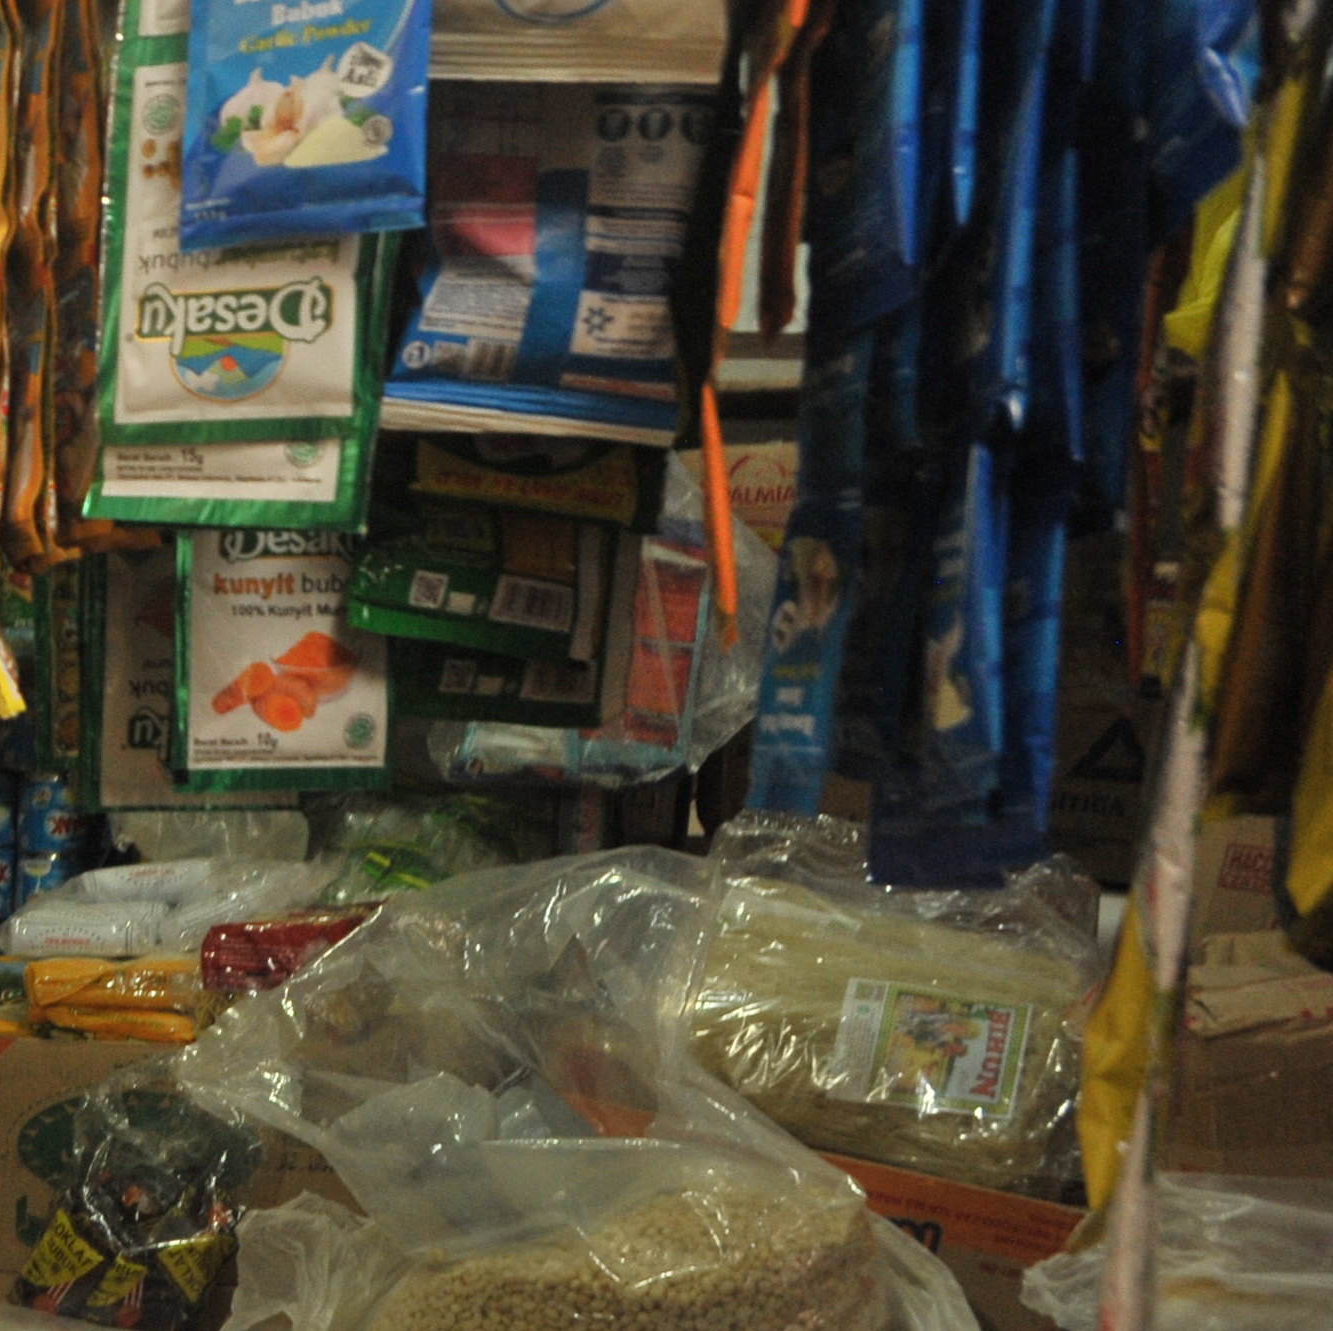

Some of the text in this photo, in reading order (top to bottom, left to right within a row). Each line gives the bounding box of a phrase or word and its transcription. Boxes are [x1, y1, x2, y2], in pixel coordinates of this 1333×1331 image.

[141, 276, 328, 357] Desaku
[213, 572, 346, 600] kunyit bub
